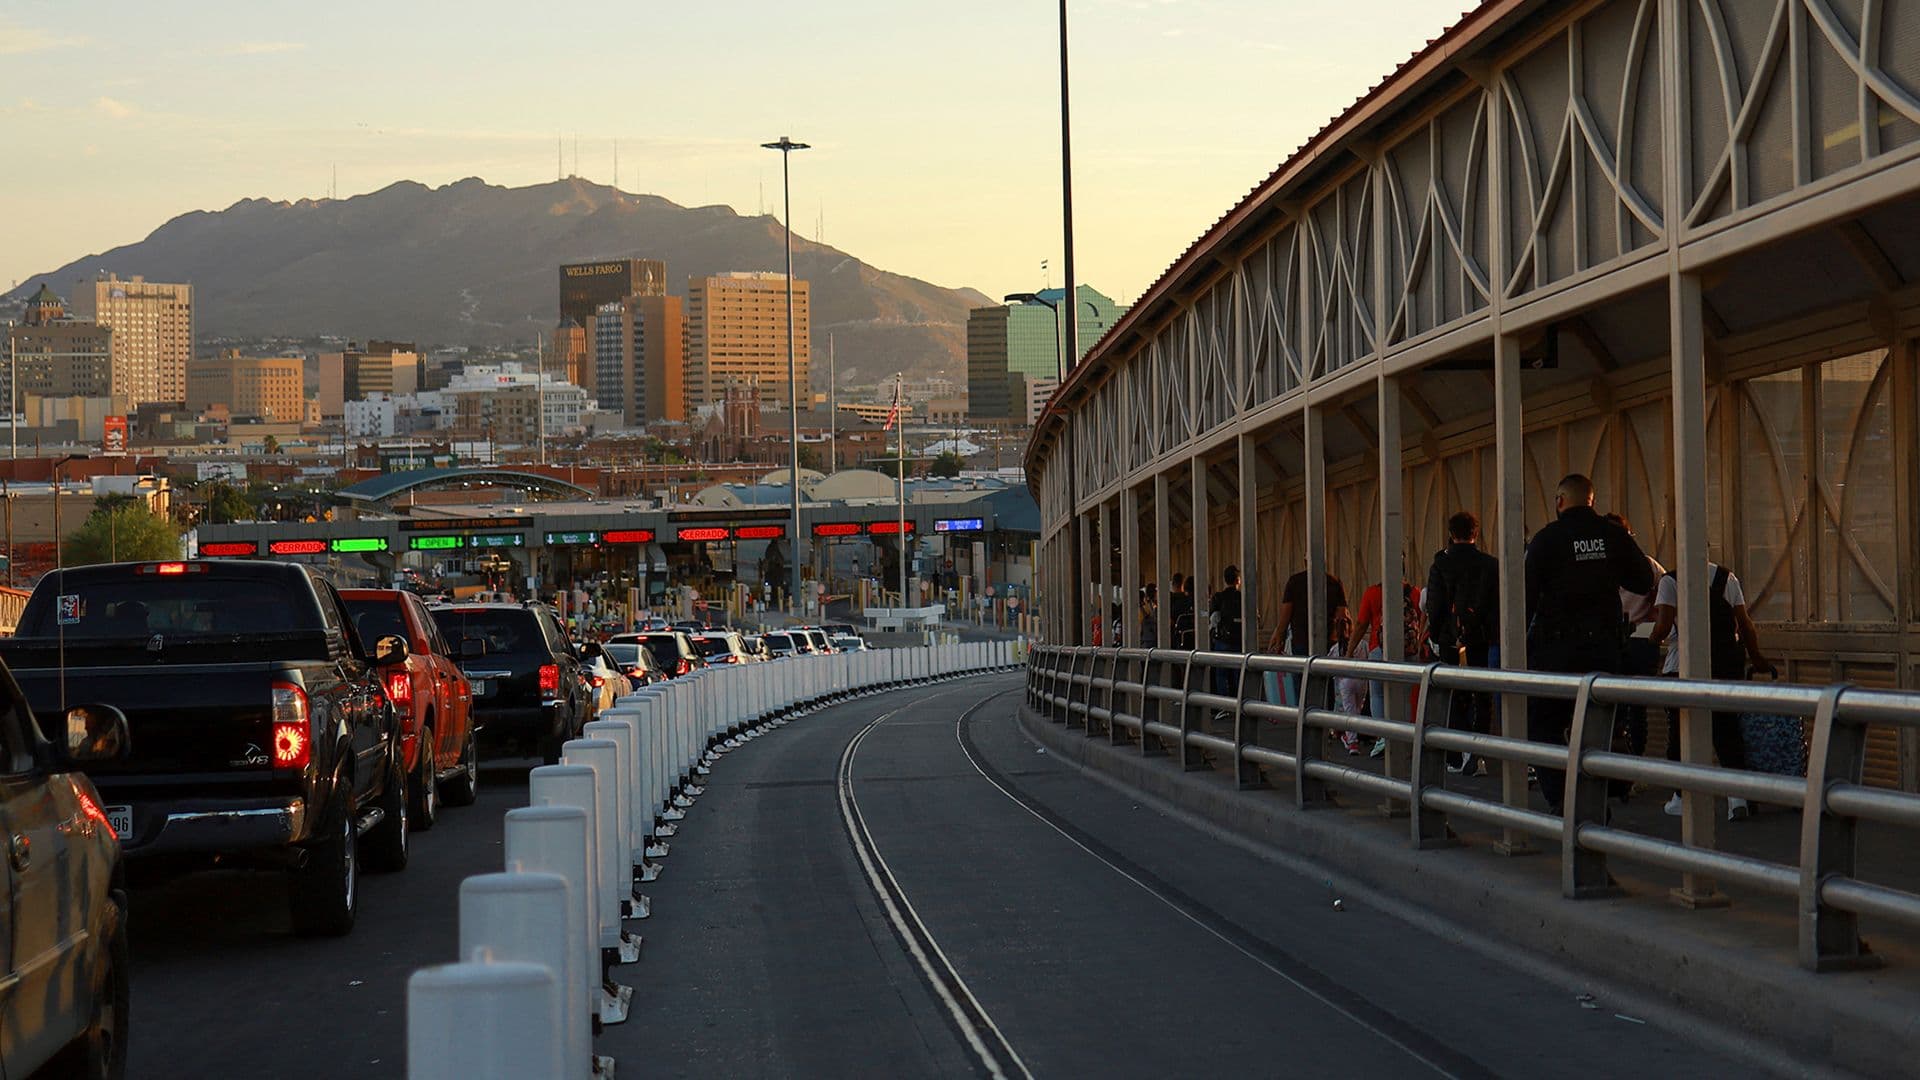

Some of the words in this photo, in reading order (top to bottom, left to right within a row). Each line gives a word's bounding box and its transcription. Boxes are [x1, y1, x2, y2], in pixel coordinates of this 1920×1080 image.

[566, 267, 594, 277] WELLS
[595, 263, 623, 275] FARGO
[685, 531, 723, 540] CERRADO
[277, 542, 320, 552] CERRADO
[425, 539, 449, 547] OPEN
[1573, 538, 1605, 553] POLICE
[247, 755, 269, 765] V8
[110, 816, 129, 832] 96
